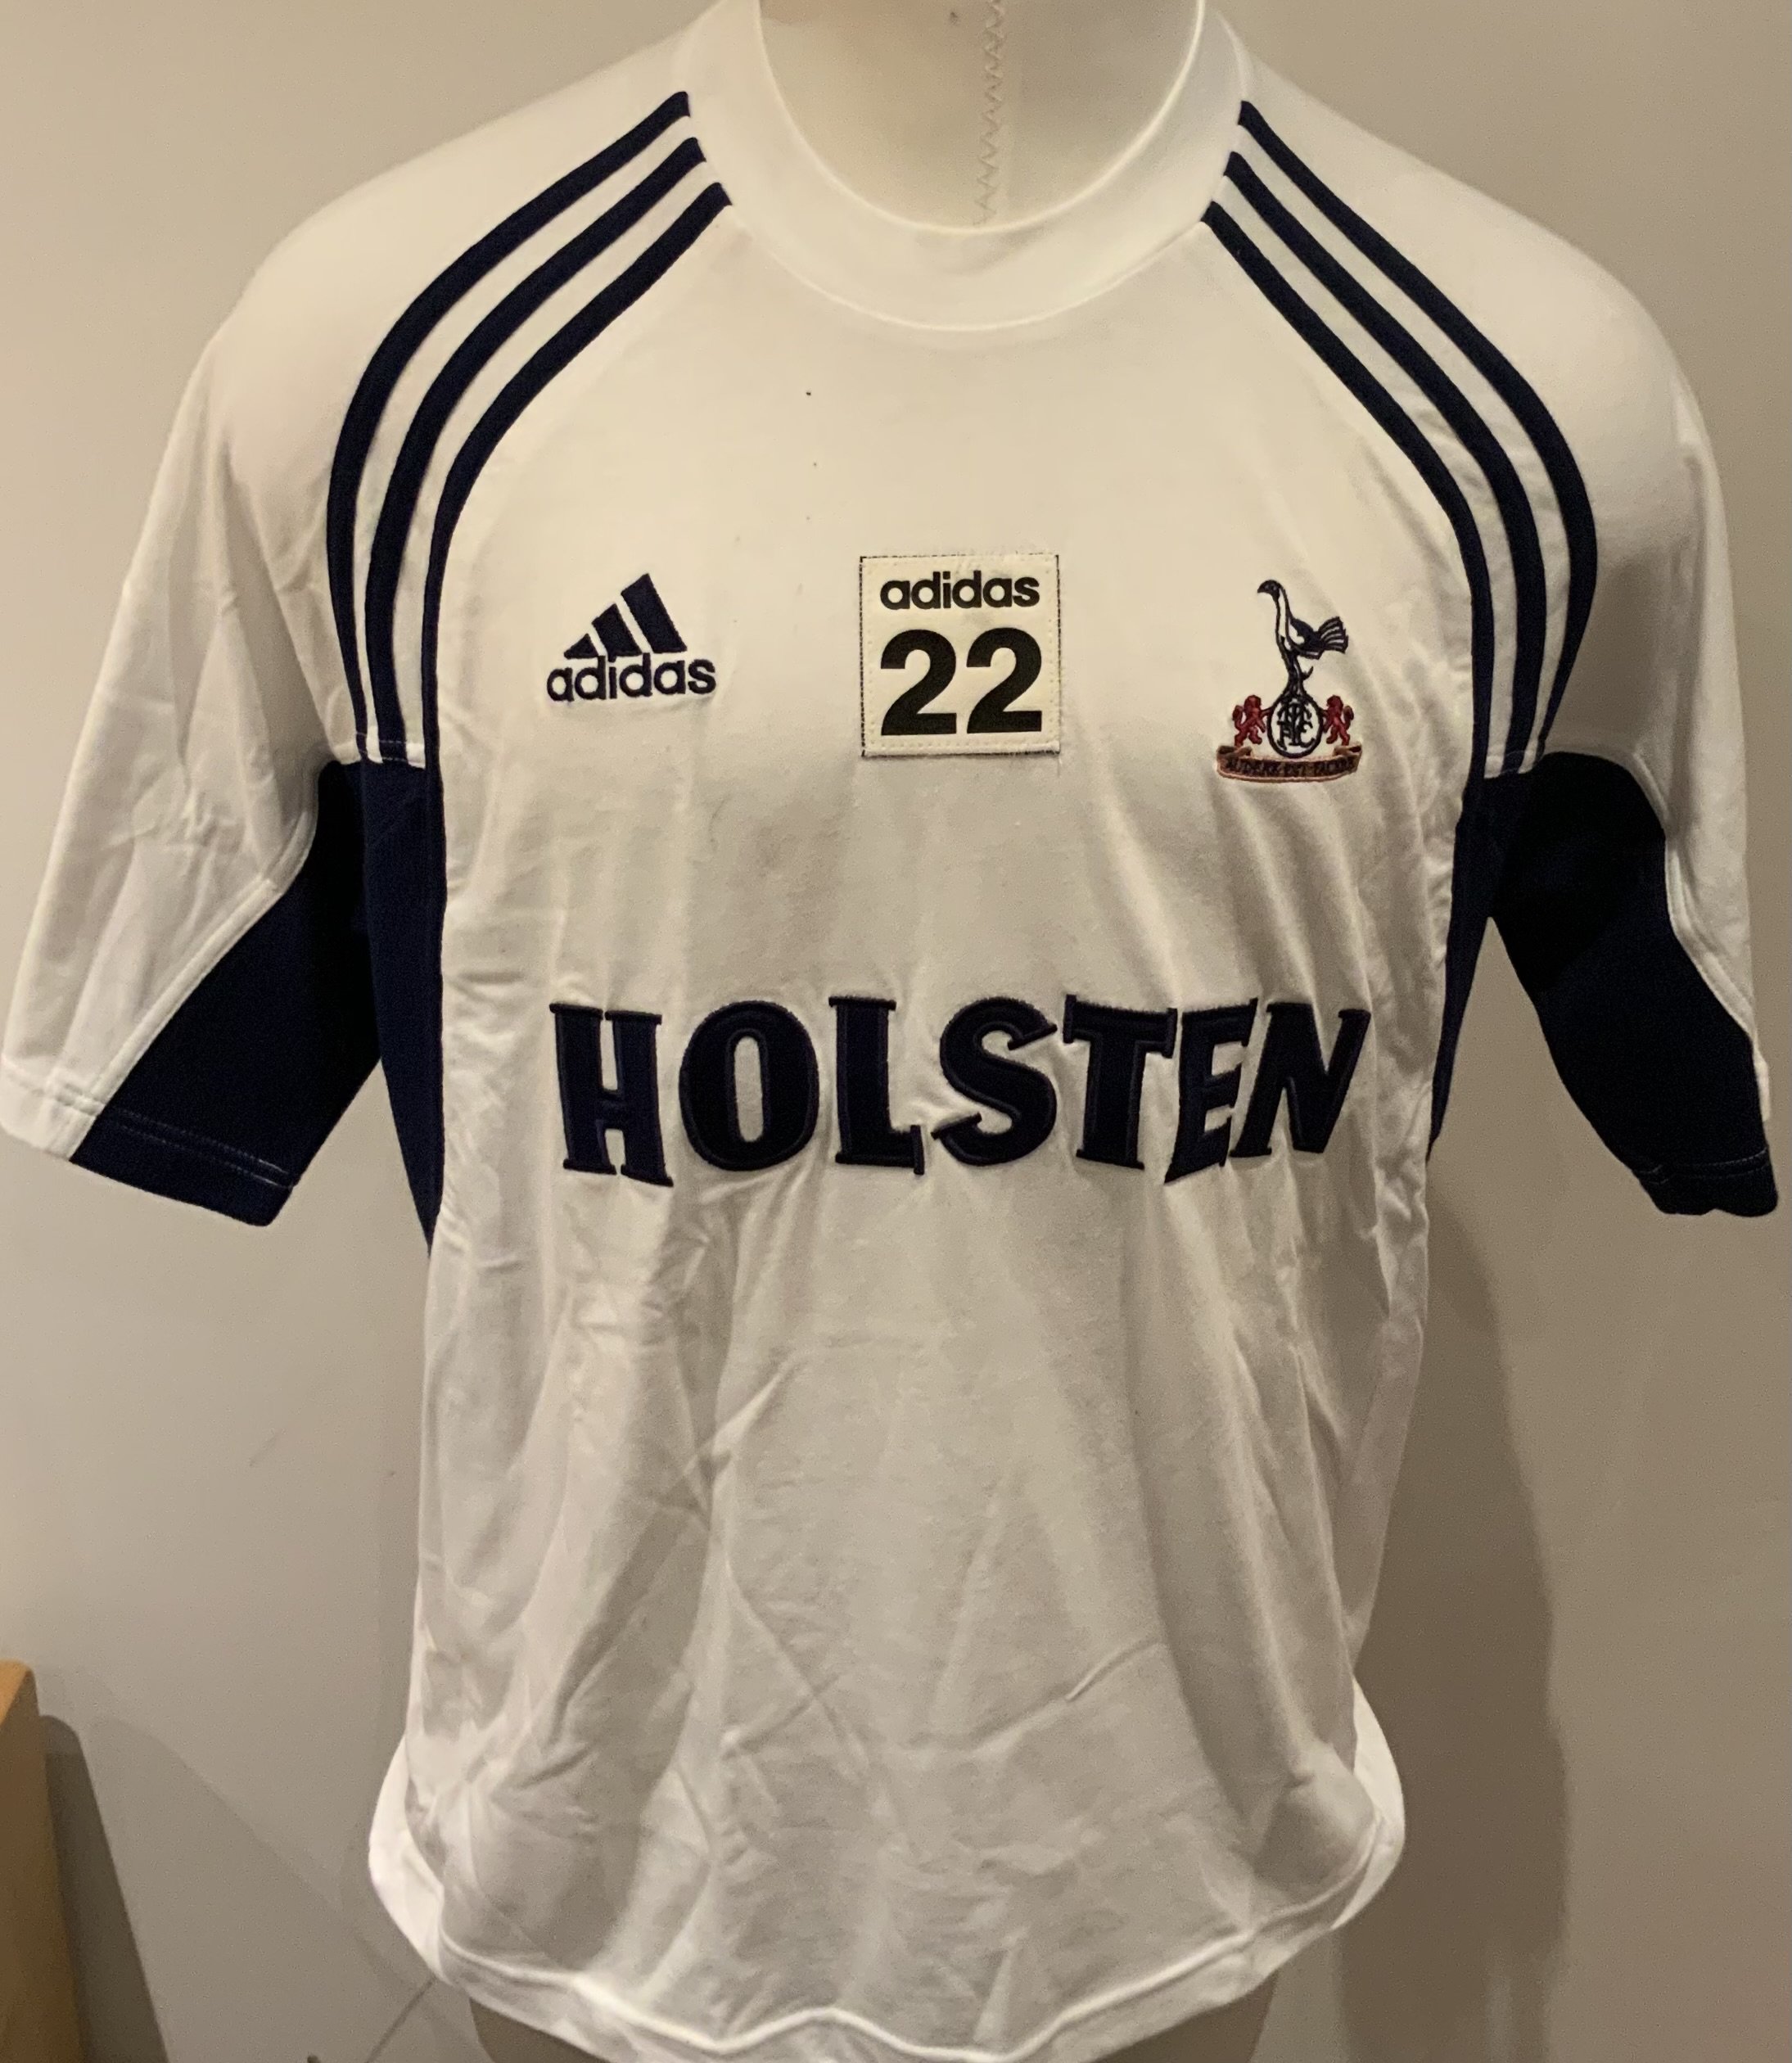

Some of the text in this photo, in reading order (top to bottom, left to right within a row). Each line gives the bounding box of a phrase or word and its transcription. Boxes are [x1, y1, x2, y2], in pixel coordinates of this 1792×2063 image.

[879, 571, 1040, 610] adidas
[546, 654, 716, 702] adidas
[880, 627, 1043, 736] 22
[549, 995, 1370, 1186] HOLSTEN
